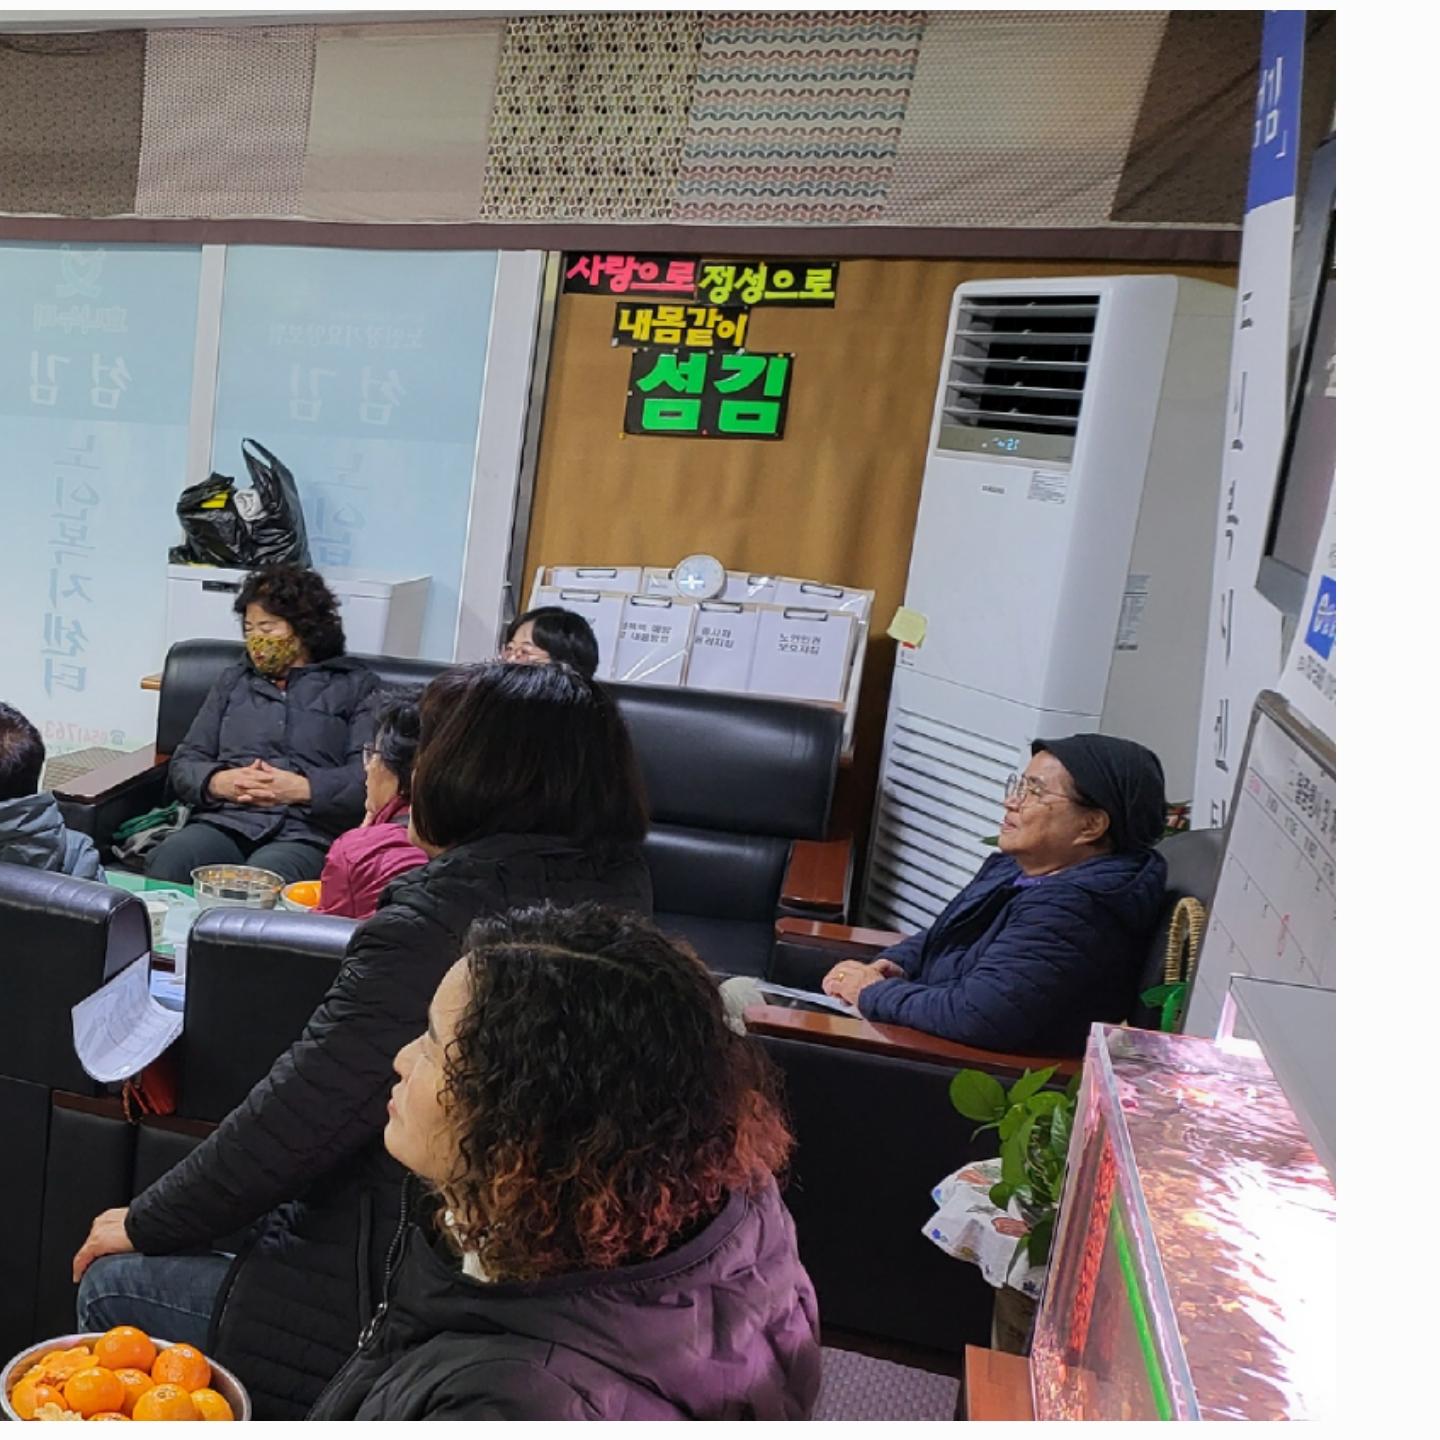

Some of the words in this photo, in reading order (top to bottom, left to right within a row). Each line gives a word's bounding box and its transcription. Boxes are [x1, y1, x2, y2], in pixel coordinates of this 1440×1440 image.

[567, 255, 696, 293] 사랑으로
[699, 264, 835, 305] 정성으로
[618, 305, 748, 347] 내몸같이
[636, 352, 789, 434] 섬김
